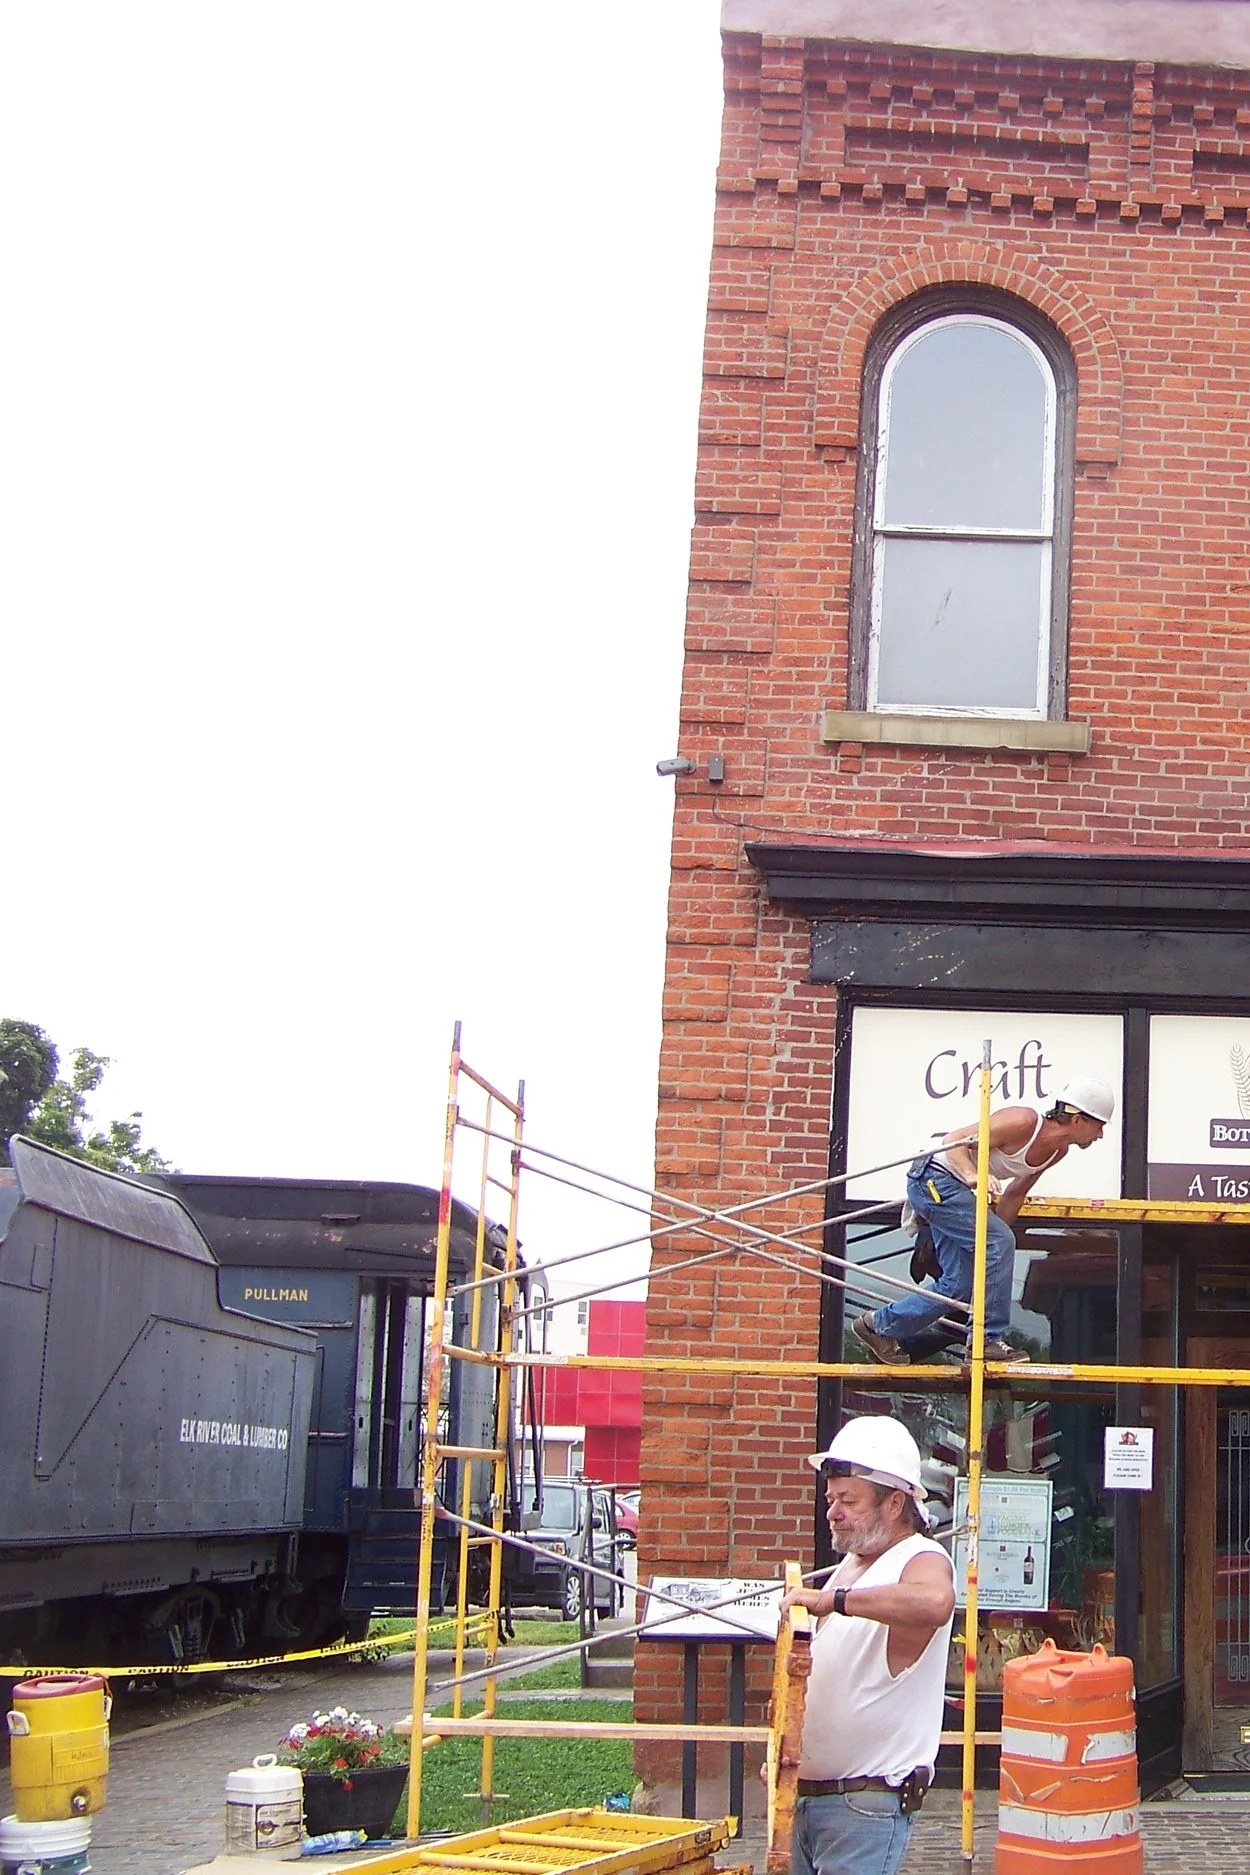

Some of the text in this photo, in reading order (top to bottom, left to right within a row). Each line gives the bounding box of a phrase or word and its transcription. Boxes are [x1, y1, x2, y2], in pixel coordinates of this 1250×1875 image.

[925, 1040, 1052, 1099] Craft
[1188, 1174, 1205, 1197] A
[244, 1288, 308, 1301] PULLMAN
[180, 1418, 288, 1450] ELK RIVER COAL & LUMBER CO
